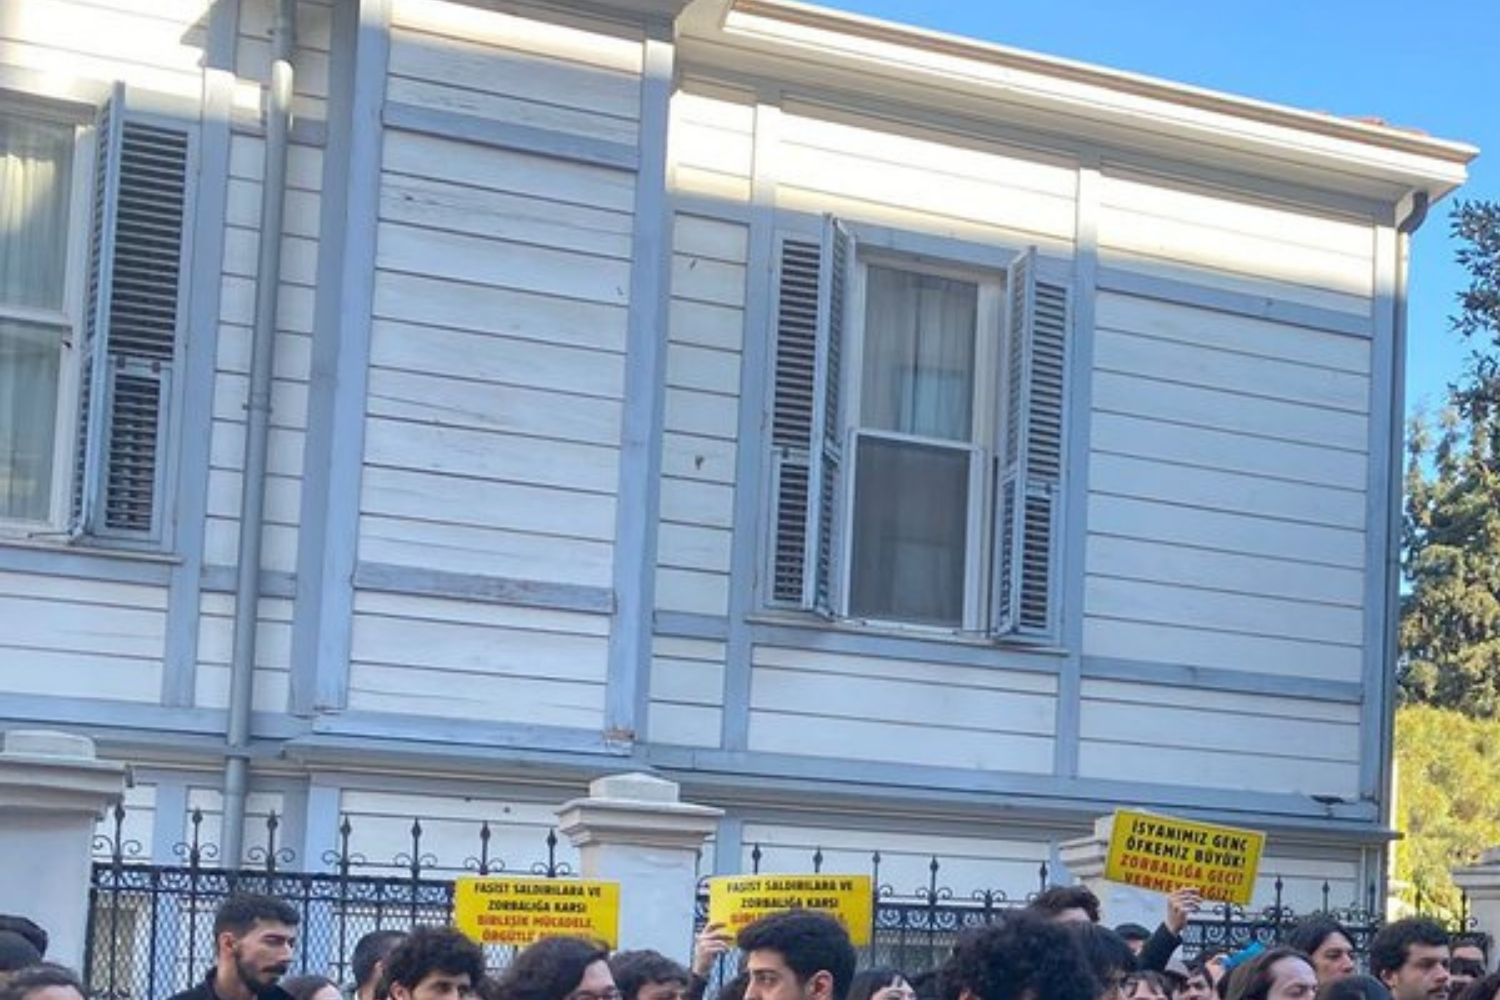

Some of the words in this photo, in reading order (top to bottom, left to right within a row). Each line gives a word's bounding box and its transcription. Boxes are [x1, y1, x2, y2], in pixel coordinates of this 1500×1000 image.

[1126, 836, 1189, 861] ÖFKEMİZ
[1195, 849, 1246, 869] BÜYÜK!
[1132, 819, 1208, 846] İSYANIMIZ
[1212, 834, 1248, 853] GENÇ
